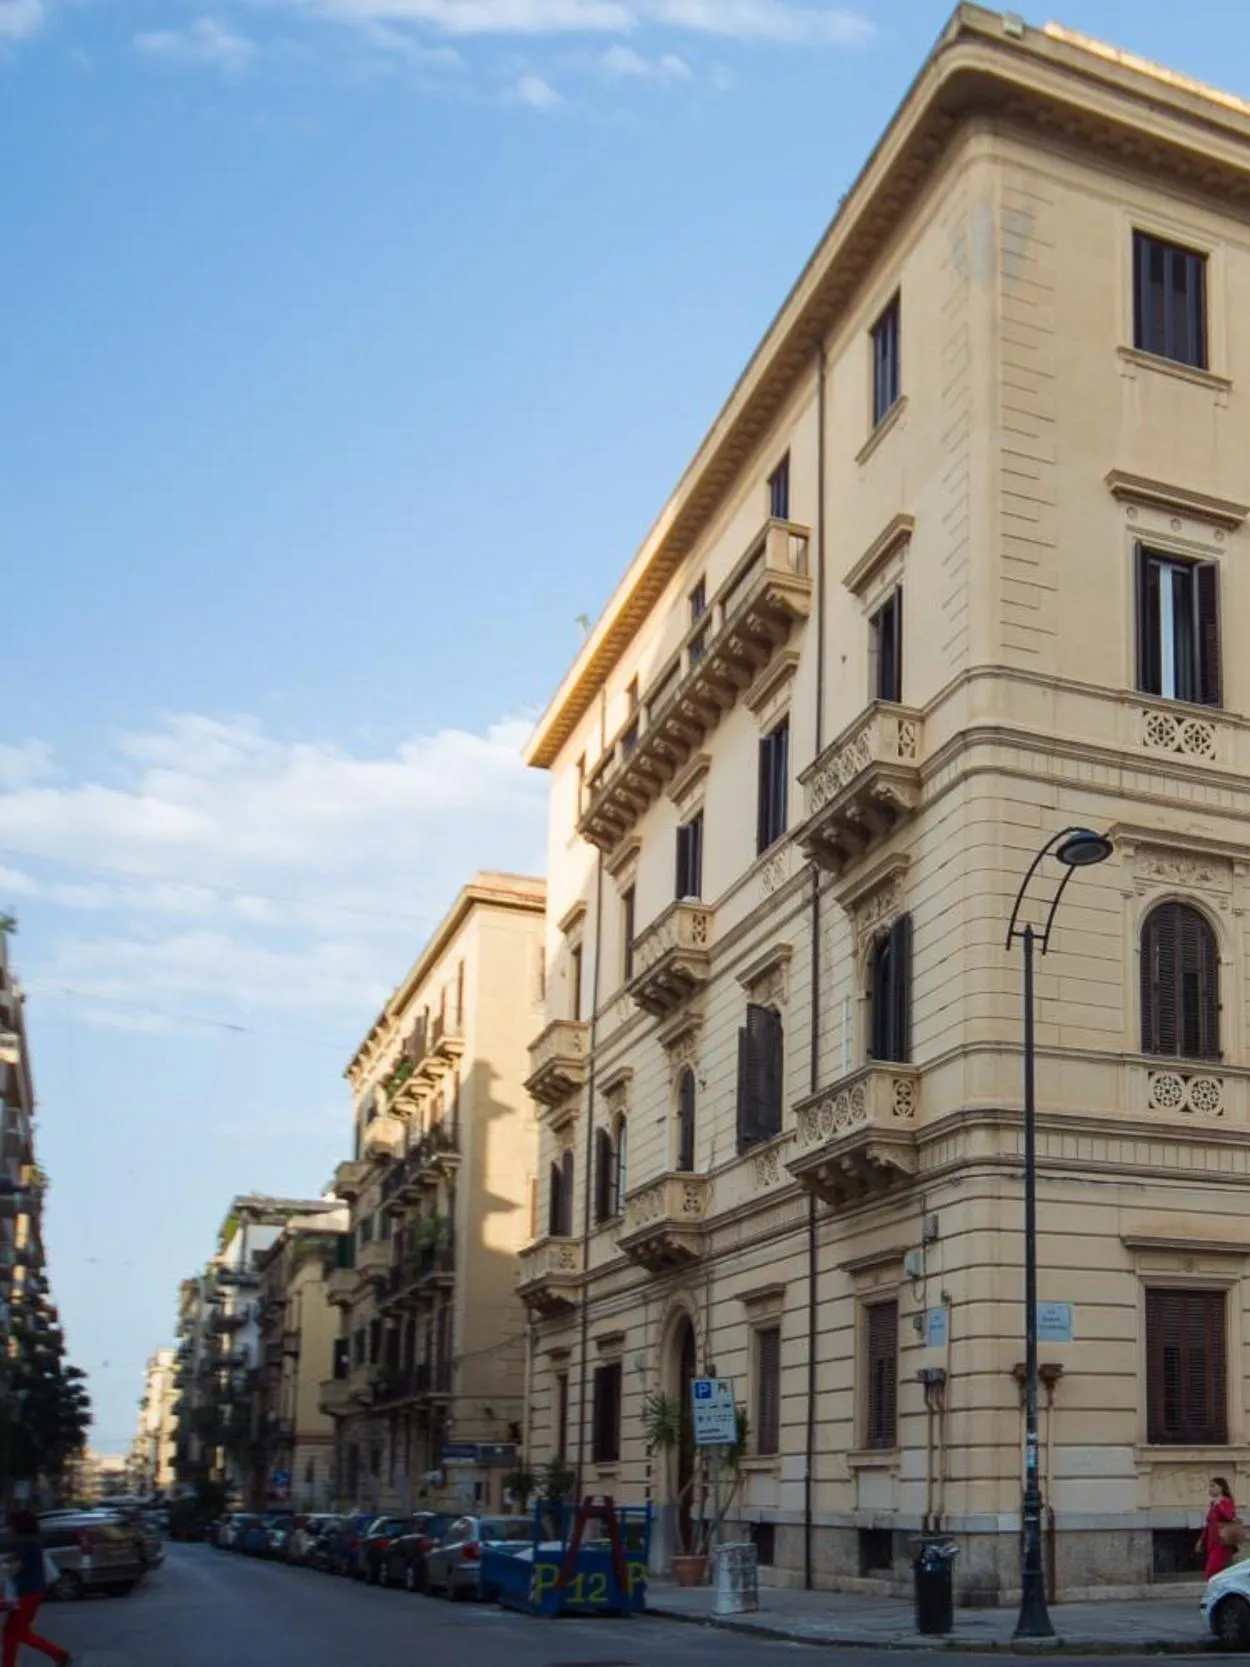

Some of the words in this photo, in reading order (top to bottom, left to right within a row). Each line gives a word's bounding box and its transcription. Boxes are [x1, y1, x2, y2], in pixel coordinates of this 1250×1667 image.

[698, 1383, 709, 1398] P
[533, 1563, 560, 1604] P
[565, 1571, 609, 1604] 12
